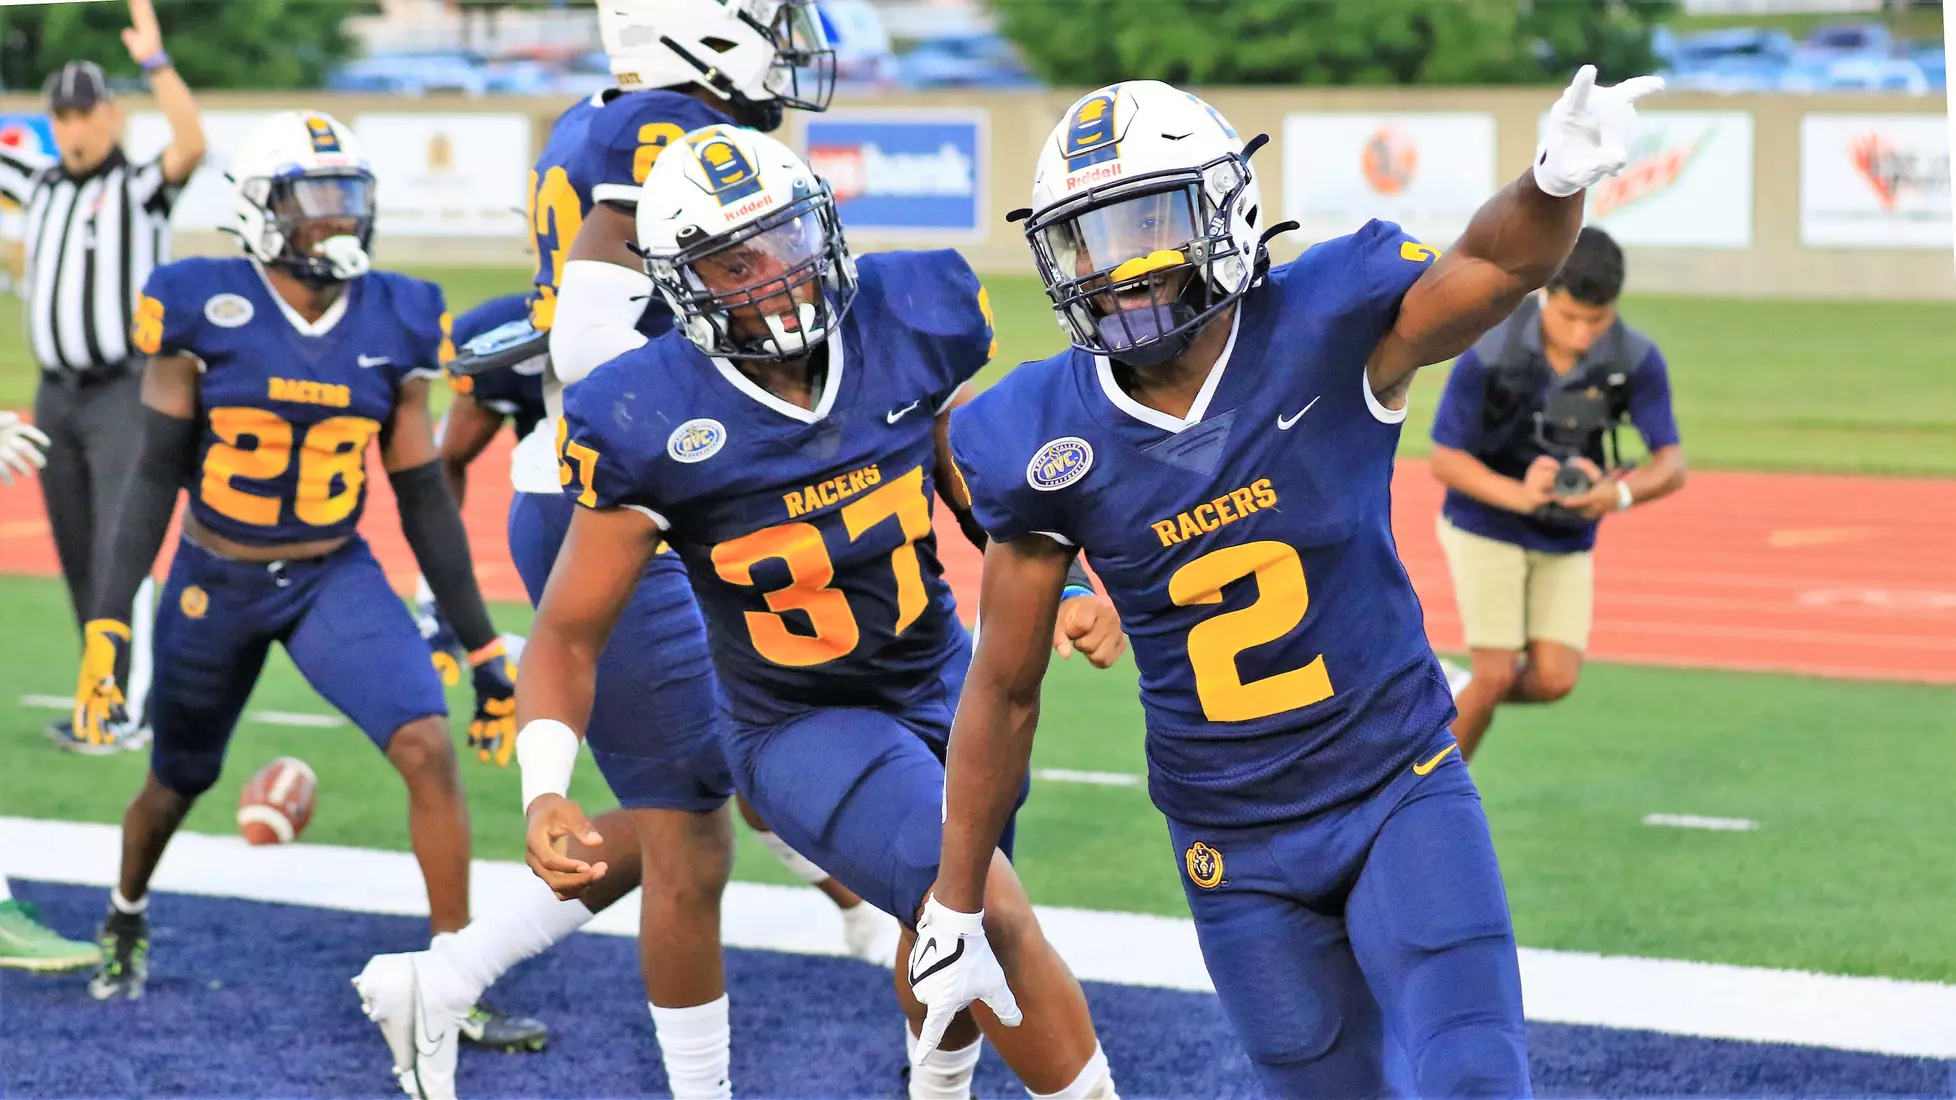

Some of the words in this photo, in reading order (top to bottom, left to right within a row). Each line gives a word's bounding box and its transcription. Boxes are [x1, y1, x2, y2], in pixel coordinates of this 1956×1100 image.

[1066, 163, 1122, 190] Riddell
[724, 195, 773, 222] Riddell
[782, 464, 881, 519] RACERS
[1043, 450, 1077, 479] OVC
[1151, 478, 1277, 547] RACERS
[711, 465, 932, 666] 37
[1168, 540, 1335, 722] 2
